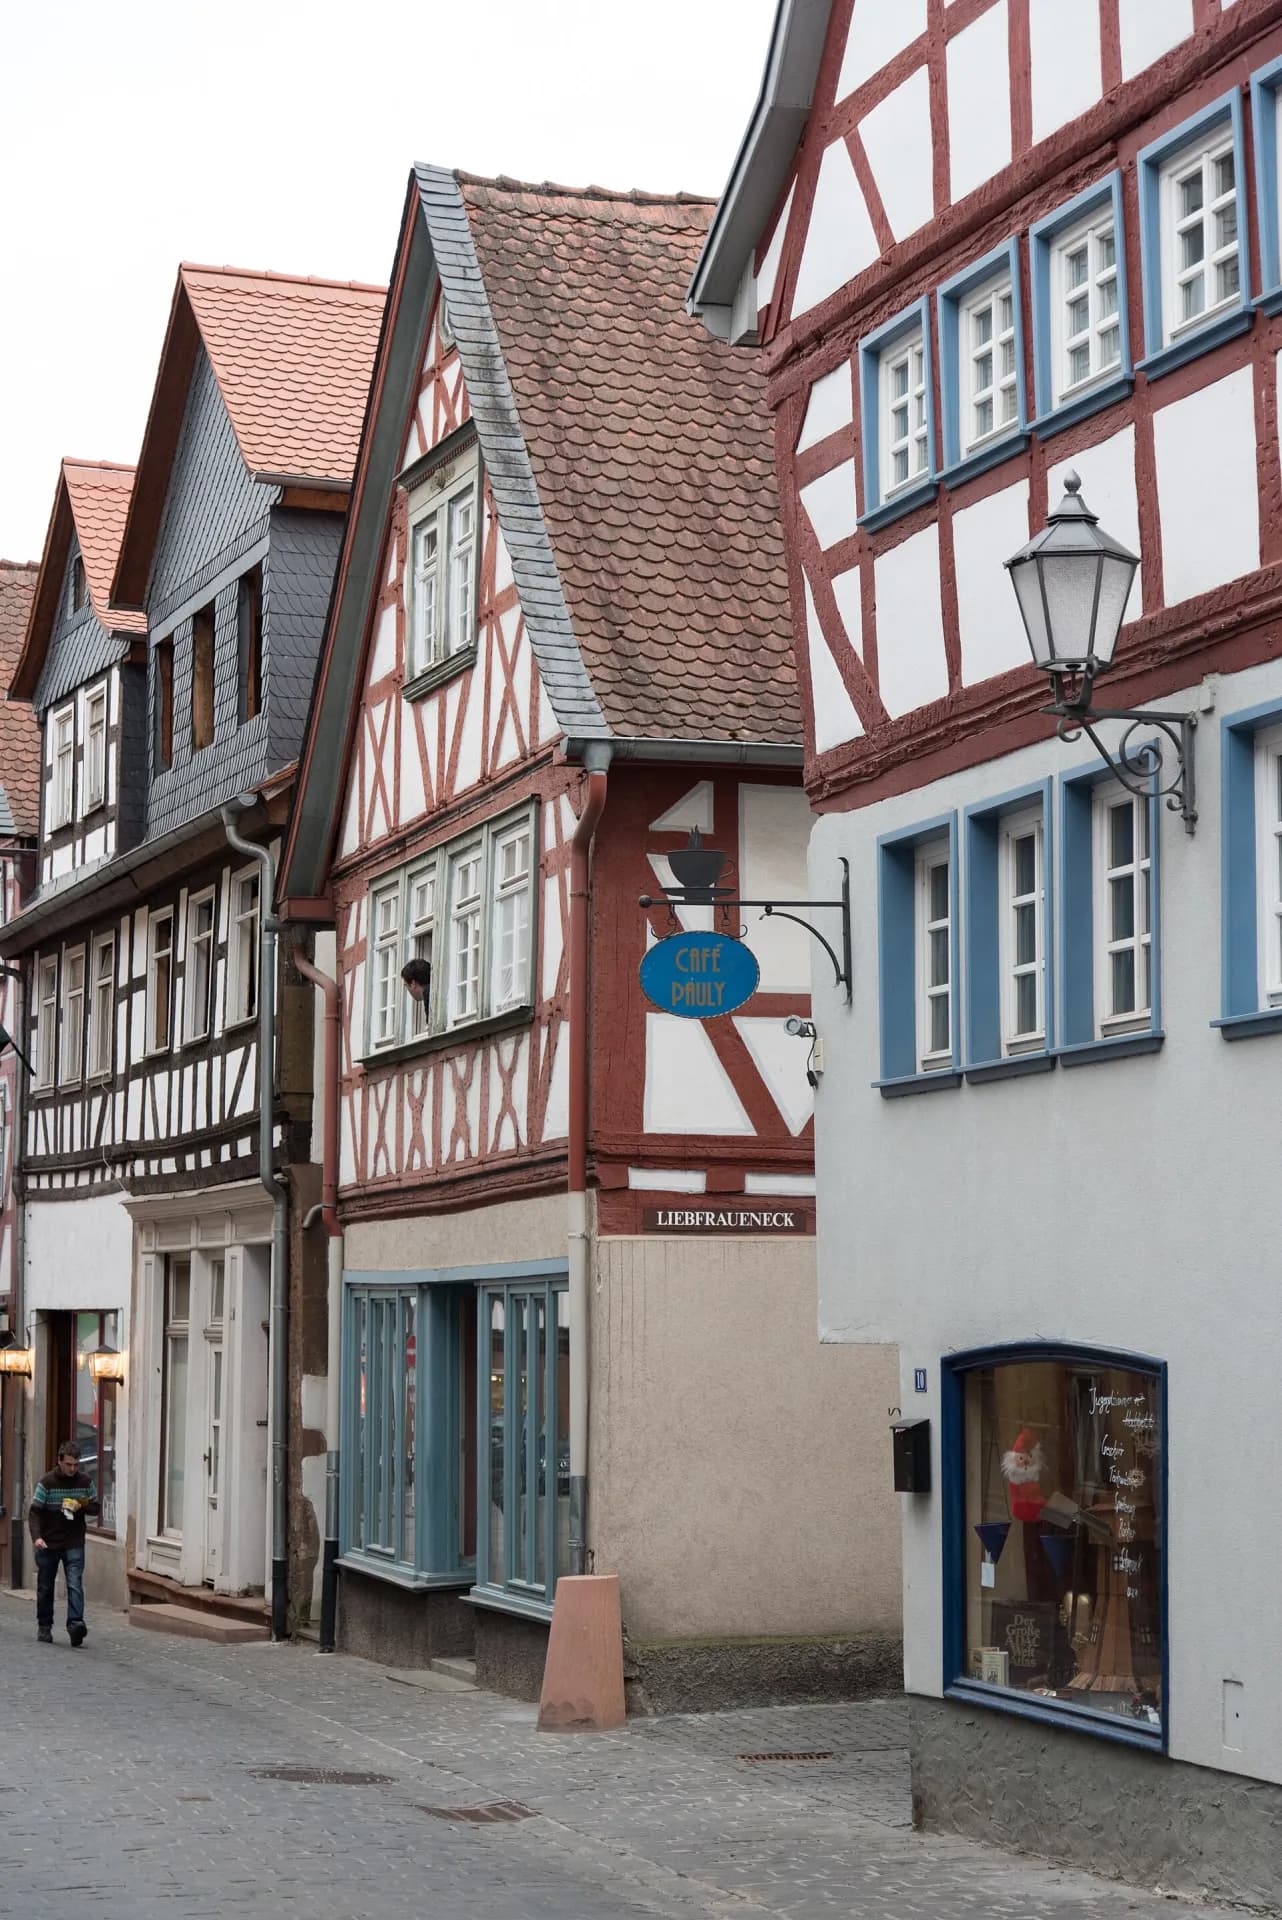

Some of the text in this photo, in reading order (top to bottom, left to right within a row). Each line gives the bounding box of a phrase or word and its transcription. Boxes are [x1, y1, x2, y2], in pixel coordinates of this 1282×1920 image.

[675, 943, 724, 972] CAFÉ
[671, 981, 726, 1007] PAULY
[656, 1211, 795, 1227] LIEBFRAUENECK
[1014, 1614, 1036, 1625] Der
[1006, 1624, 1041, 1637] Große
